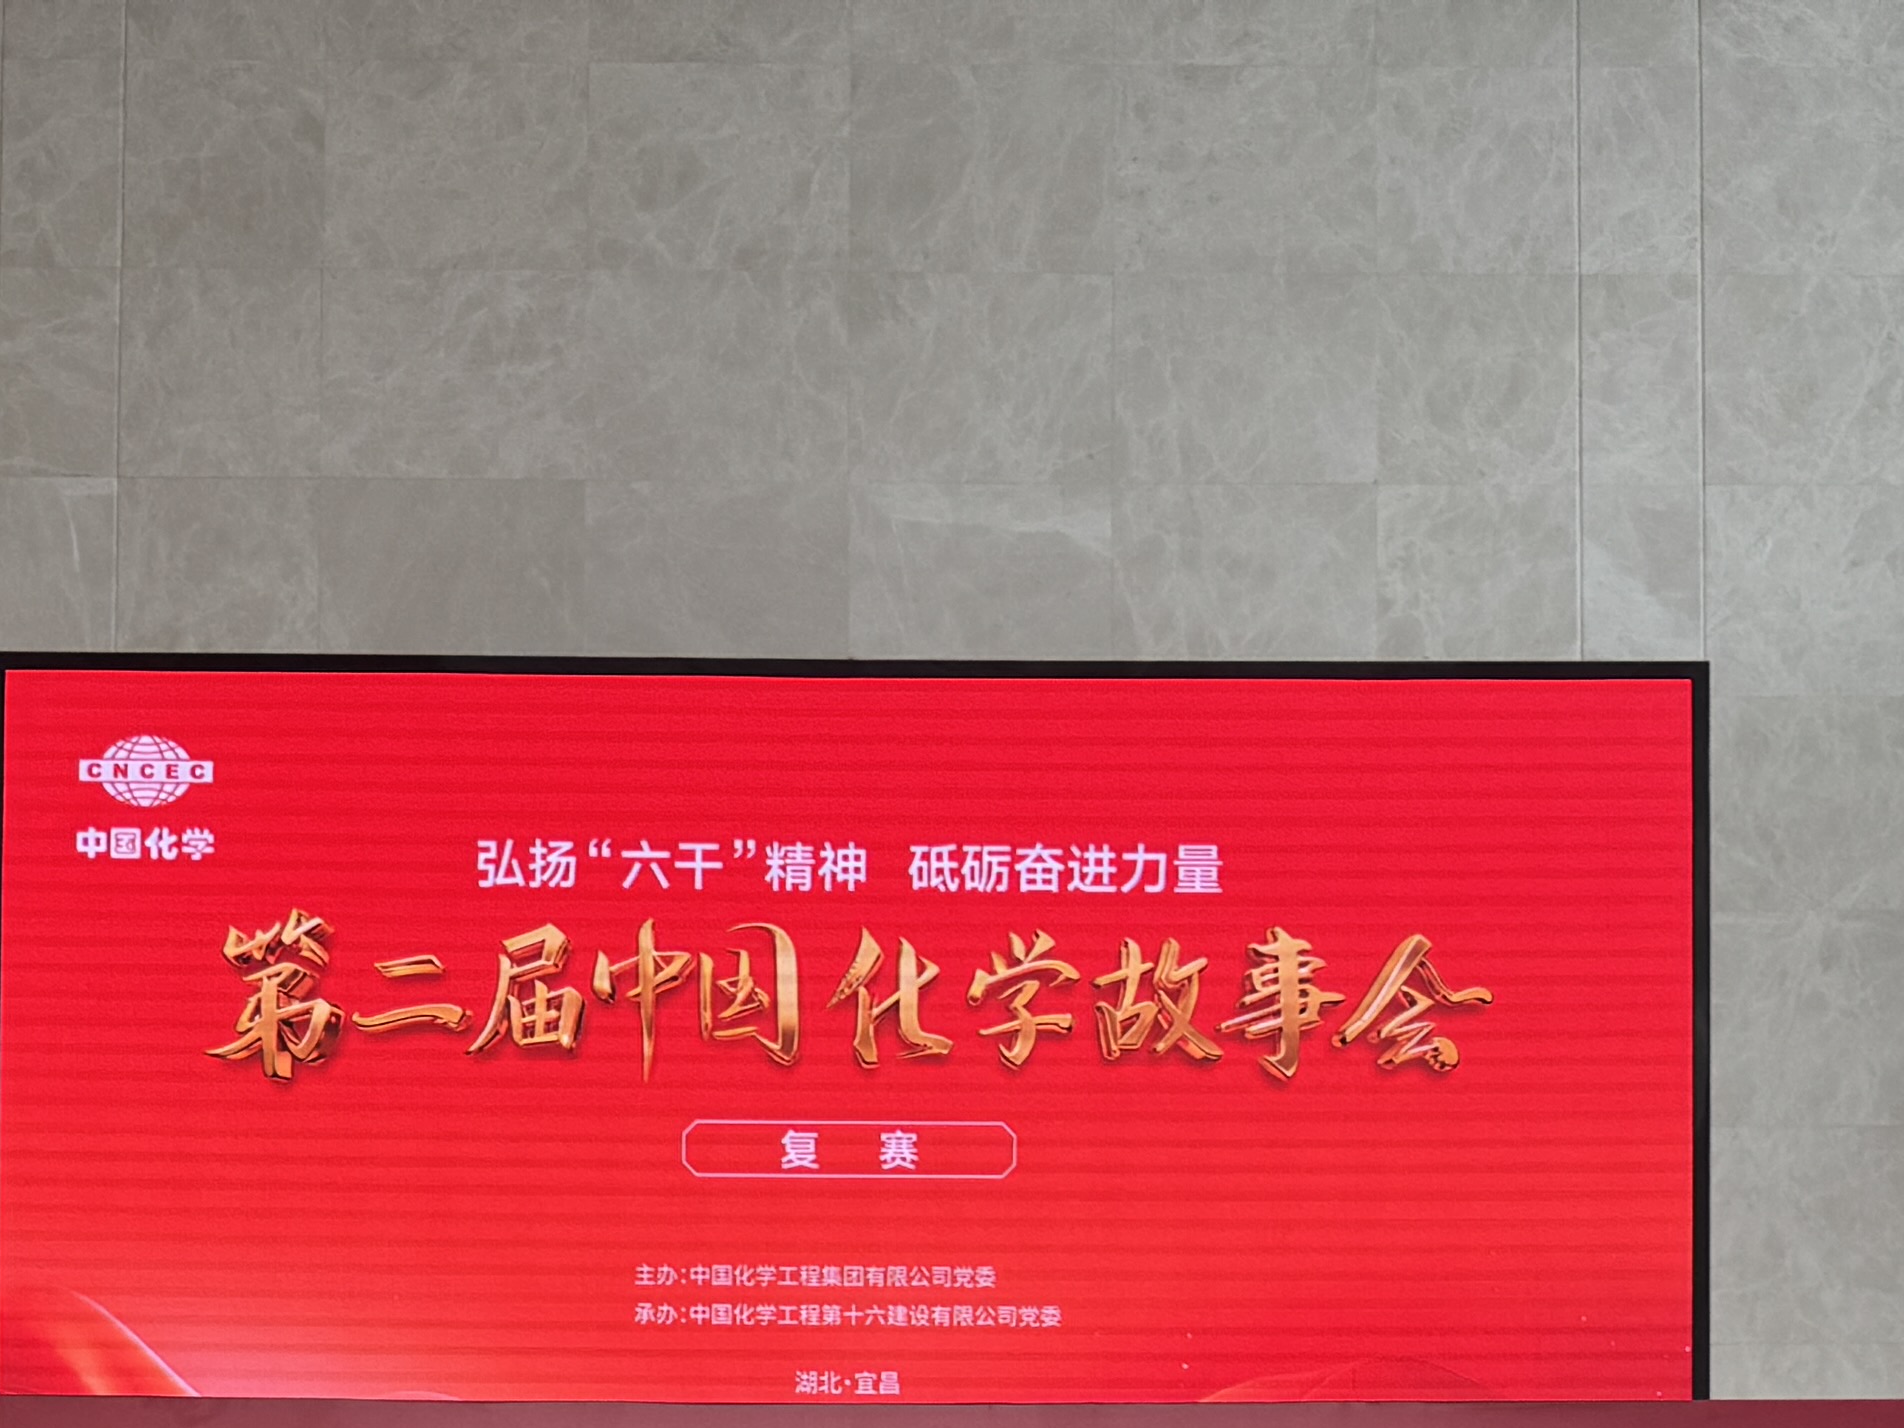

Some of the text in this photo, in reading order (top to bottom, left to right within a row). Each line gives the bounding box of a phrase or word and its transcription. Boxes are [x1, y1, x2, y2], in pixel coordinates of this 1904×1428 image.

[85, 762, 207, 780] CNCEC
[76, 826, 215, 861] 中国化学
[476, 837, 1224, 895] 弘扬“六干”精神 砥砺奋进力量
[202, 908, 1496, 1084] 第二届中国化学故事会
